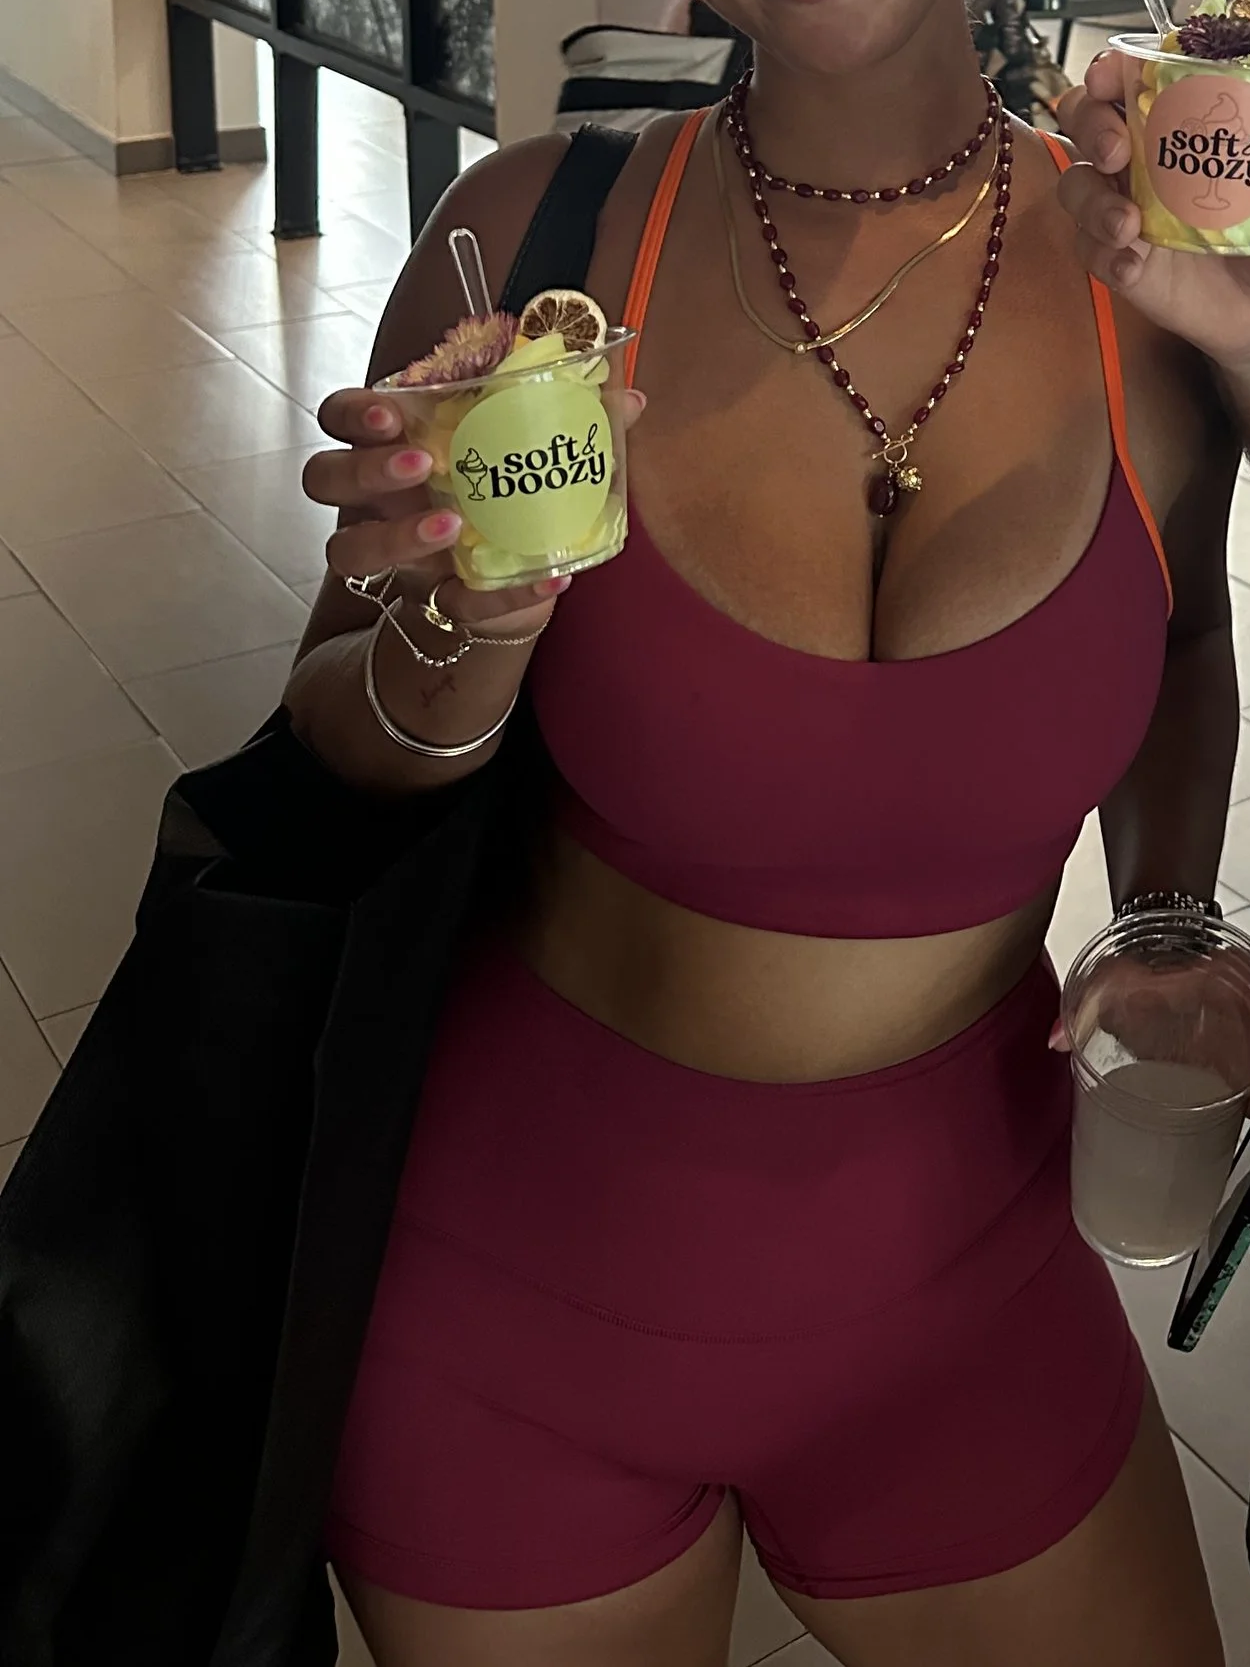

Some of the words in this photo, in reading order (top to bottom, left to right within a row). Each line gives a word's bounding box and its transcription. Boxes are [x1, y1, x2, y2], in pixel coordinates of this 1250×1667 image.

[1170, 127, 1240, 158] soft
[503, 434, 578, 474] soft
[581, 423, 598, 456] &
[489, 451, 606, 499] boozy
